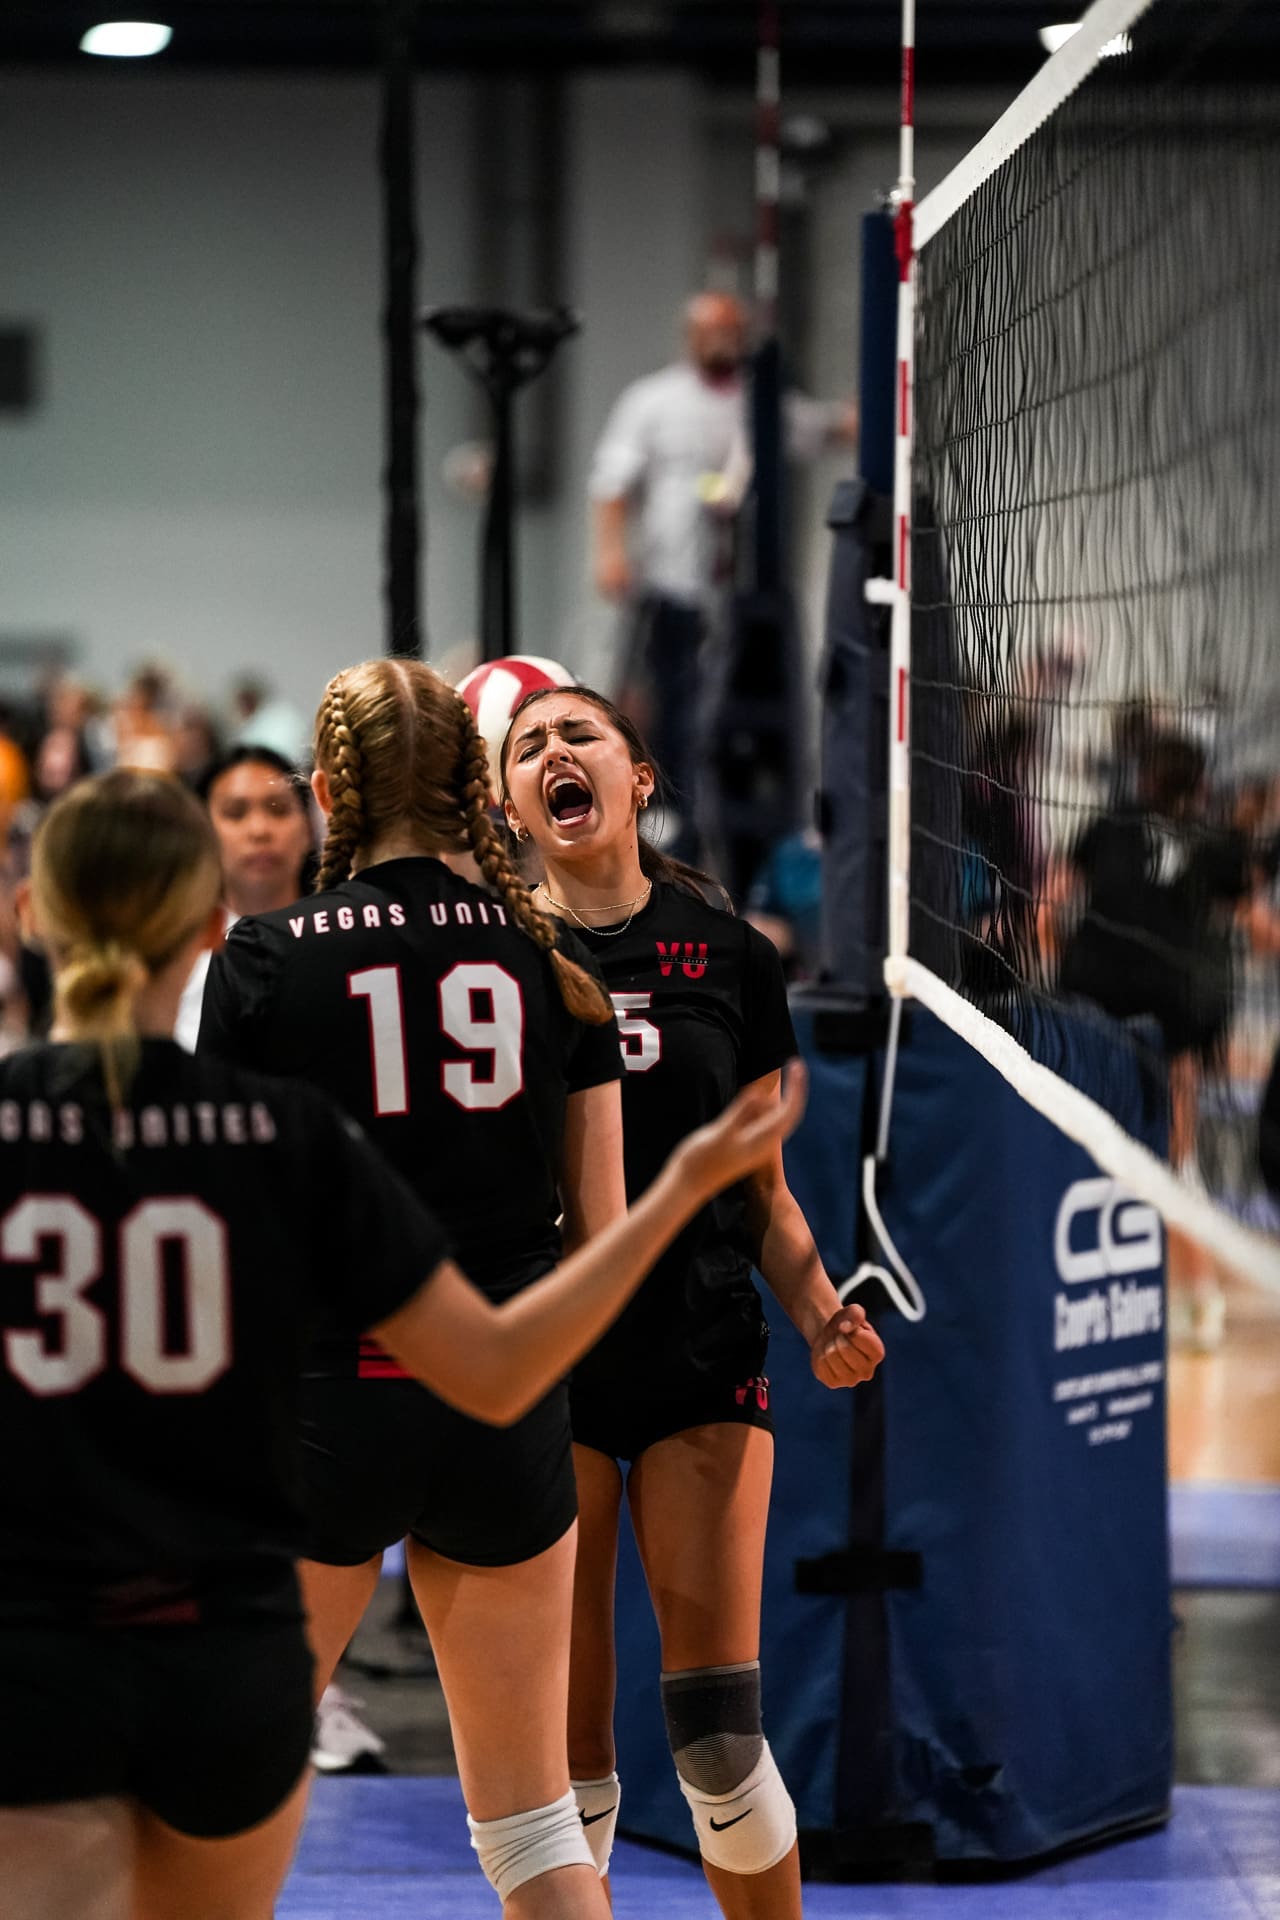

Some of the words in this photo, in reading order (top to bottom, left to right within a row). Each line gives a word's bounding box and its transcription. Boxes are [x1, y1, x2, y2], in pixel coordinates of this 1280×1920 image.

[288, 903, 406, 939] VEGAS
[429, 901, 508, 927] UNIT
[655, 941, 708, 979] VU
[346, 961, 526, 1118] 19
[0, 1193, 233, 1397] 30
